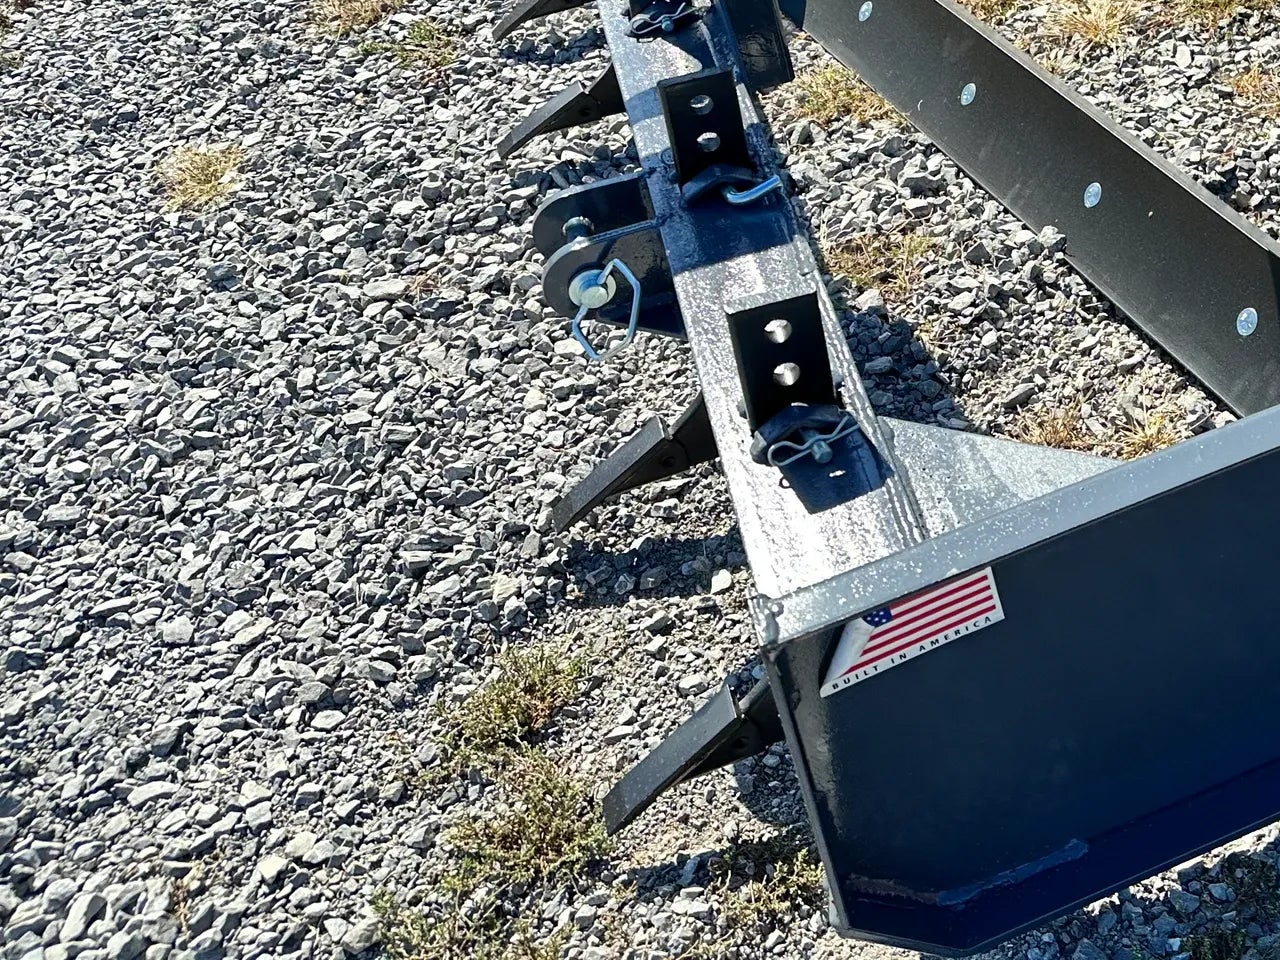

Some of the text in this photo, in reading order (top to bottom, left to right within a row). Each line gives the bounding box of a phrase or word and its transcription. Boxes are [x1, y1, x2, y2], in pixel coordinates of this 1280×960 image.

[831, 615, 993, 690] BUILT IN AMERICA
